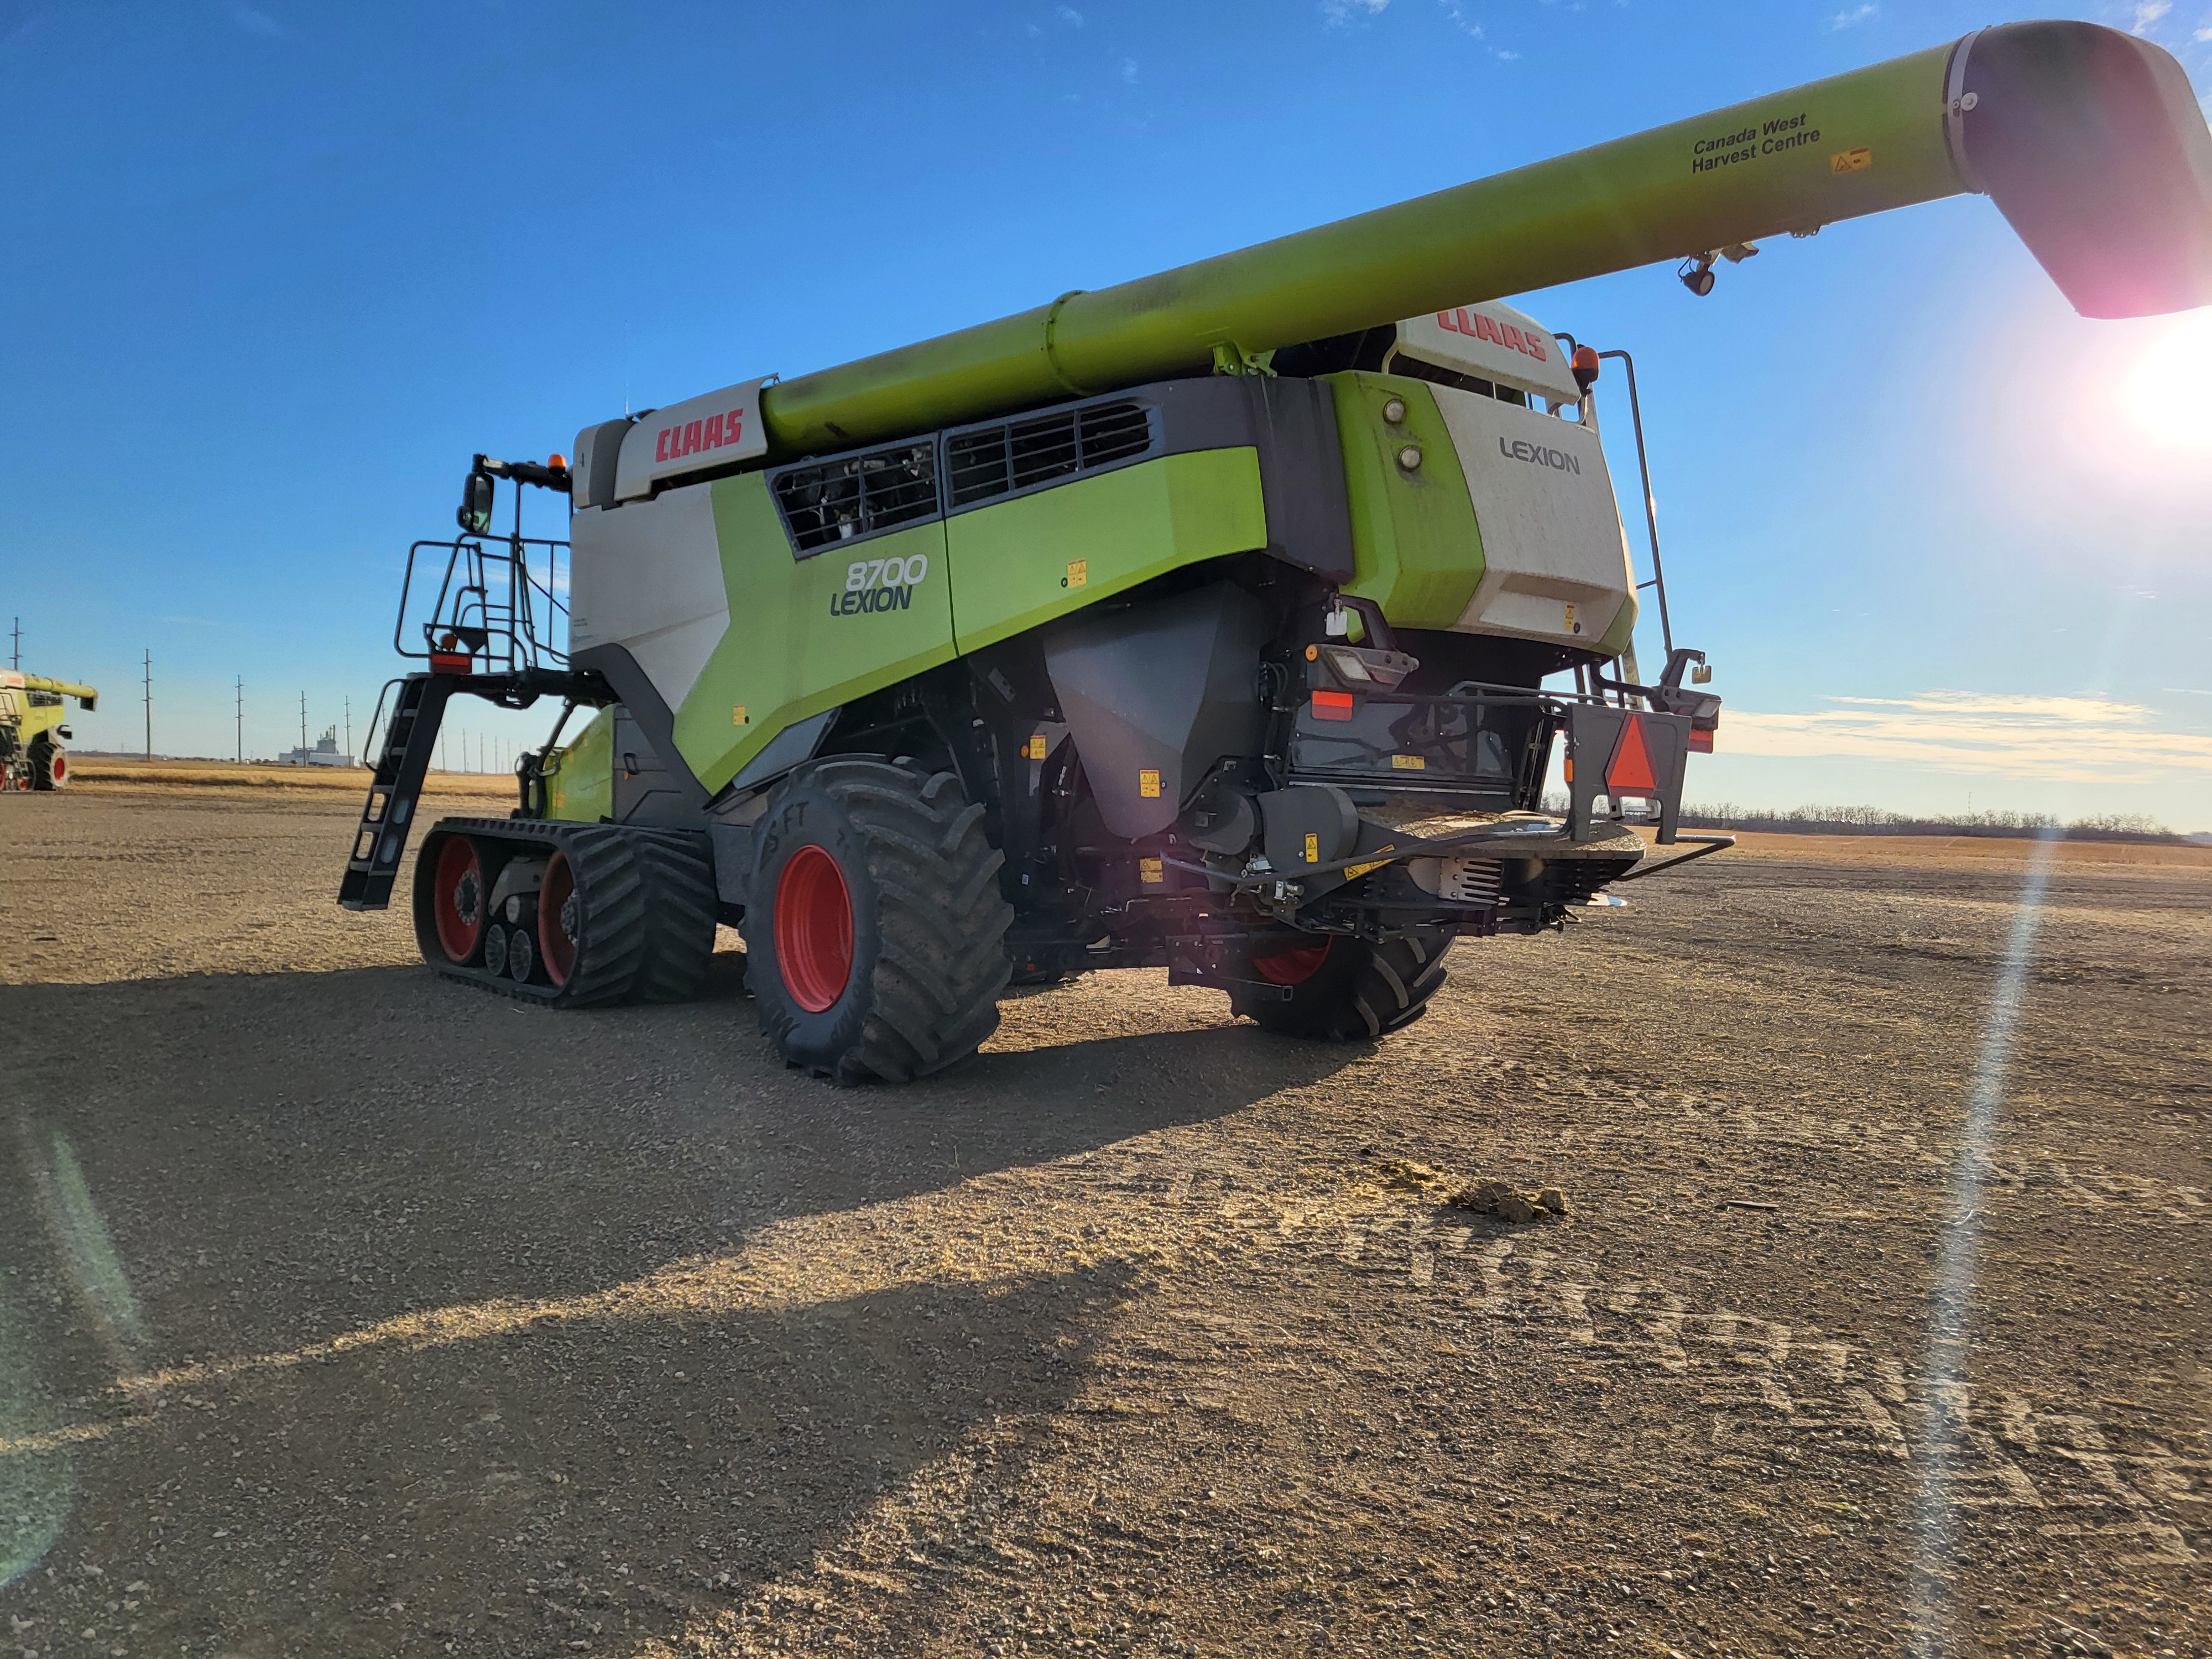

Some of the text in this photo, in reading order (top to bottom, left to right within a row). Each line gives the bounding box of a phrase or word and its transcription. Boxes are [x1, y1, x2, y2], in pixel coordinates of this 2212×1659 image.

[1692, 129, 1820, 174] Harvest Centre
[1694, 113, 1807, 155] Canada West
[1437, 308, 1547, 362] CLAAS
[656, 408, 744, 463] CLAAS
[1500, 436, 1580, 476] LEXION
[846, 554, 928, 592] 8700
[831, 585, 912, 616] LEXION
